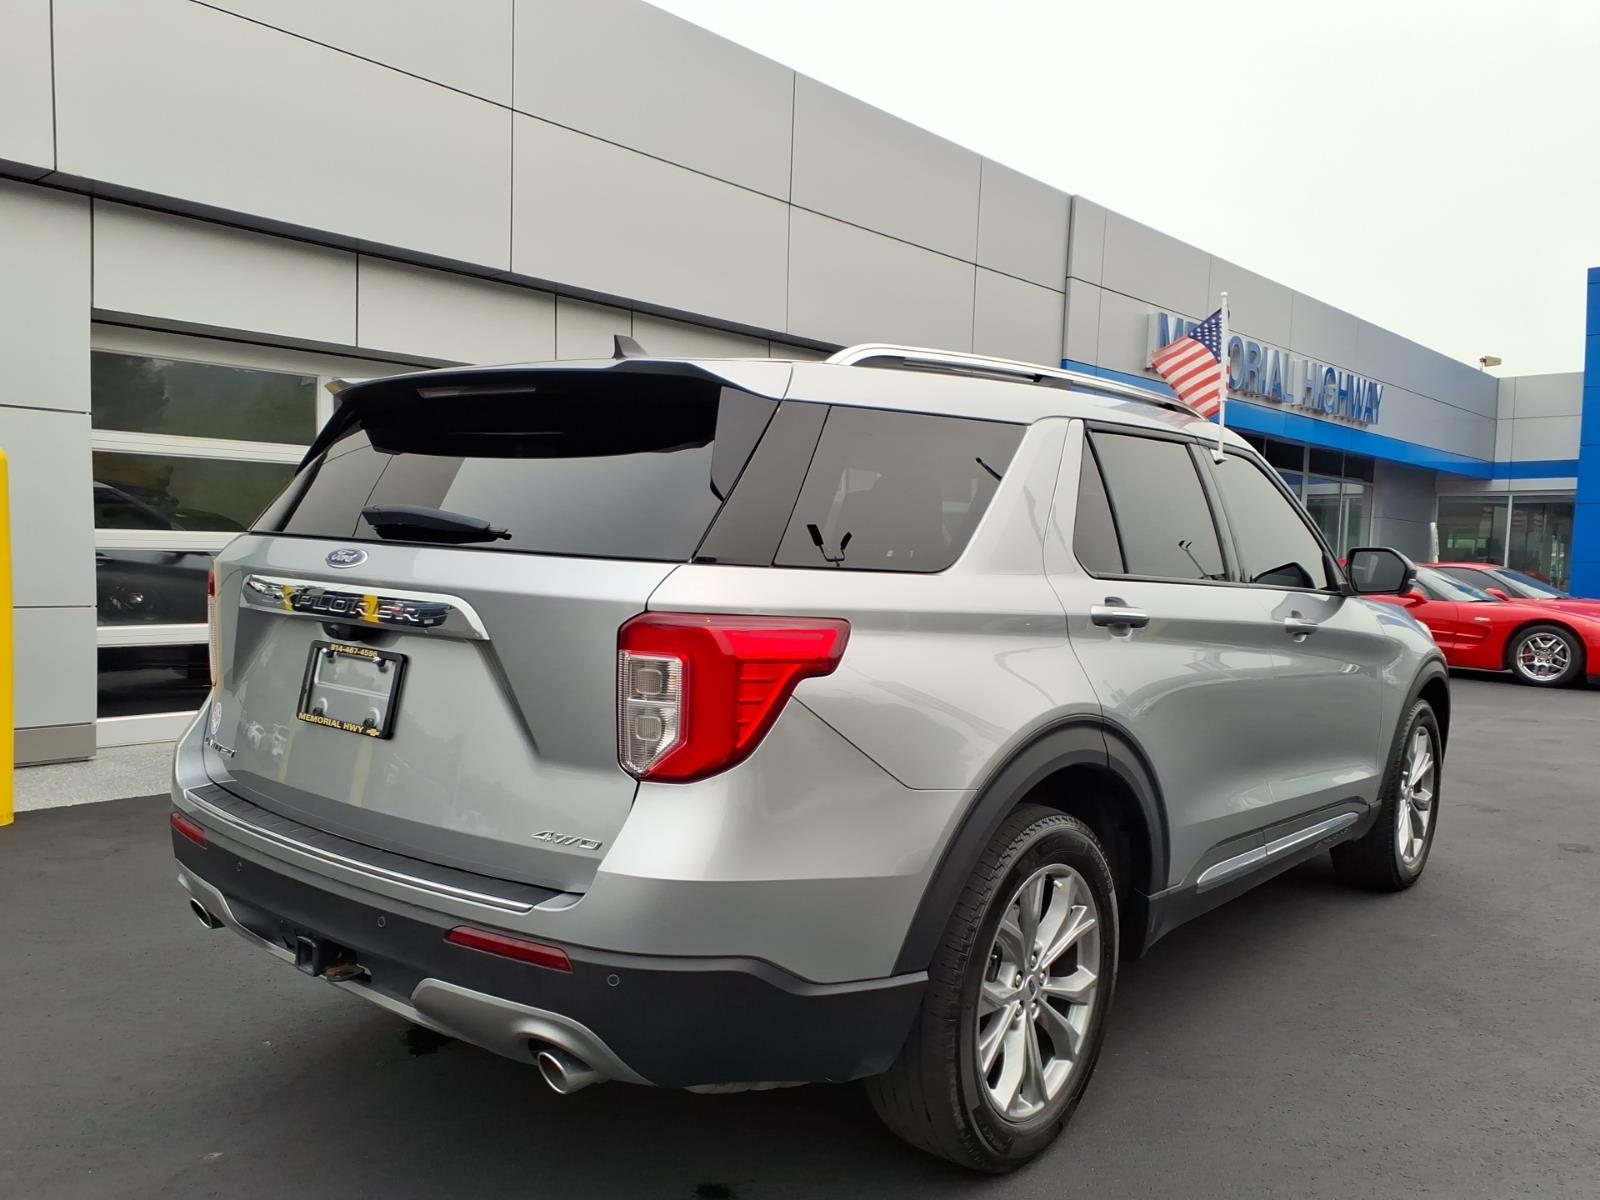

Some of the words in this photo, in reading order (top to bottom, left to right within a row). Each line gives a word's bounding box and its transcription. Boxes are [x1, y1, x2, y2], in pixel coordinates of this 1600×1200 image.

[1146, 311, 1294, 403] MORIAL
[1294, 358, 1384, 425] HIGHWAY
[298, 711, 342, 729] MEMORIAL
[343, 722, 365, 734] HWY
[530, 830, 602, 851] 4WD
